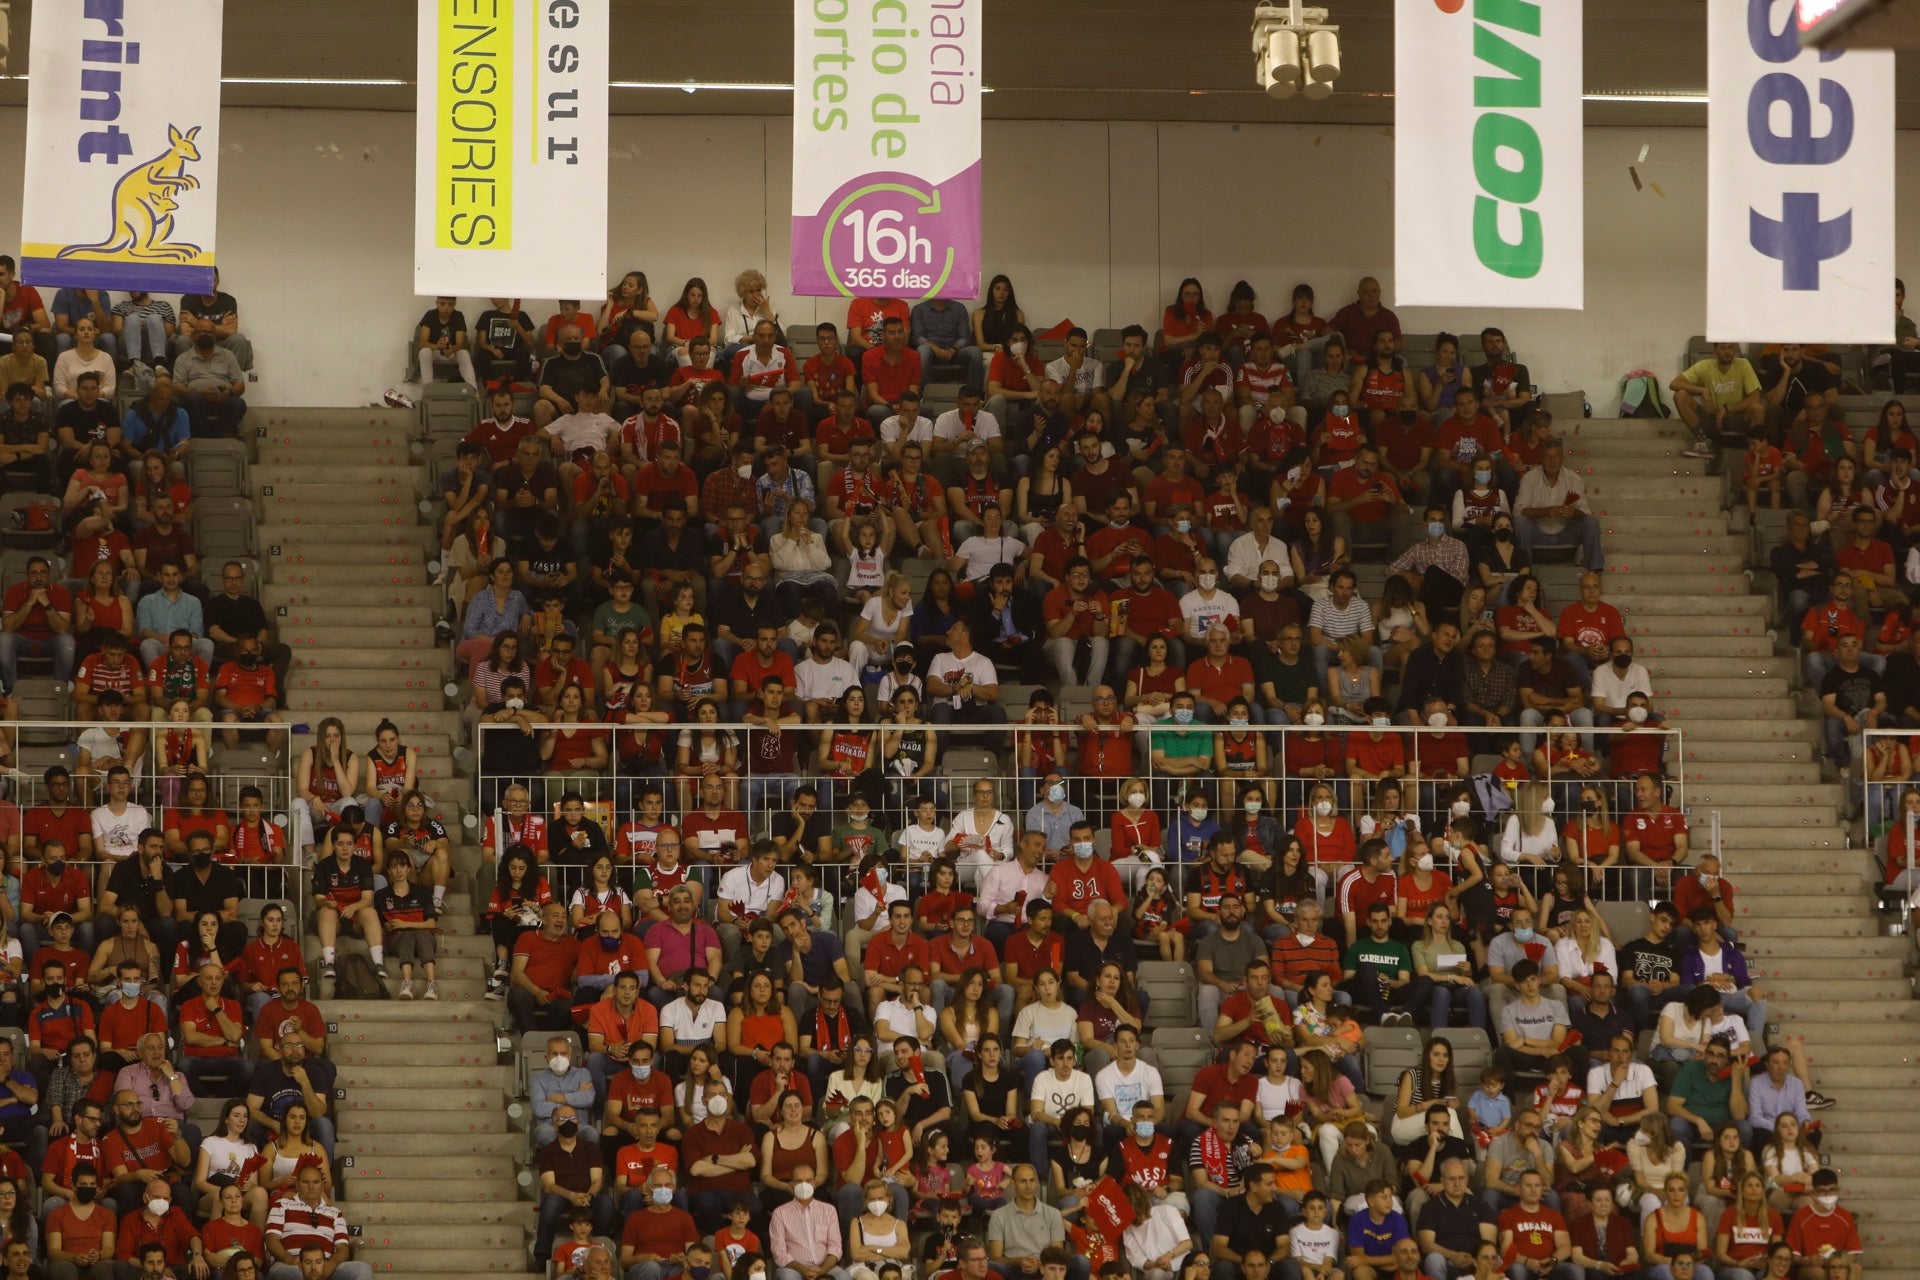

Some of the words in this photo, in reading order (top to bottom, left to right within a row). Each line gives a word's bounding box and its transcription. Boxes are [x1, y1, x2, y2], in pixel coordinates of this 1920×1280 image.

[871, 92, 920, 159] de
[843, 209, 932, 265] 16h
[844, 269, 887, 288] 365
[892, 268, 931, 290] días
[259, 428, 265, 436] 7
[265, 487, 272, 495] 6
[273, 547, 279, 555] 5
[835, 744, 866, 759] GRANADA
[1072, 877, 1101, 900] 31
[1359, 953, 1400, 965] CARHARTT
[328, 1023, 337, 1032] 10
[337, 1090, 344, 1099] 9
[345, 1158, 353, 1167] 8
[353, 1226, 360, 1235] 7
[1517, 1221, 1553, 1234] ESPAÑA
